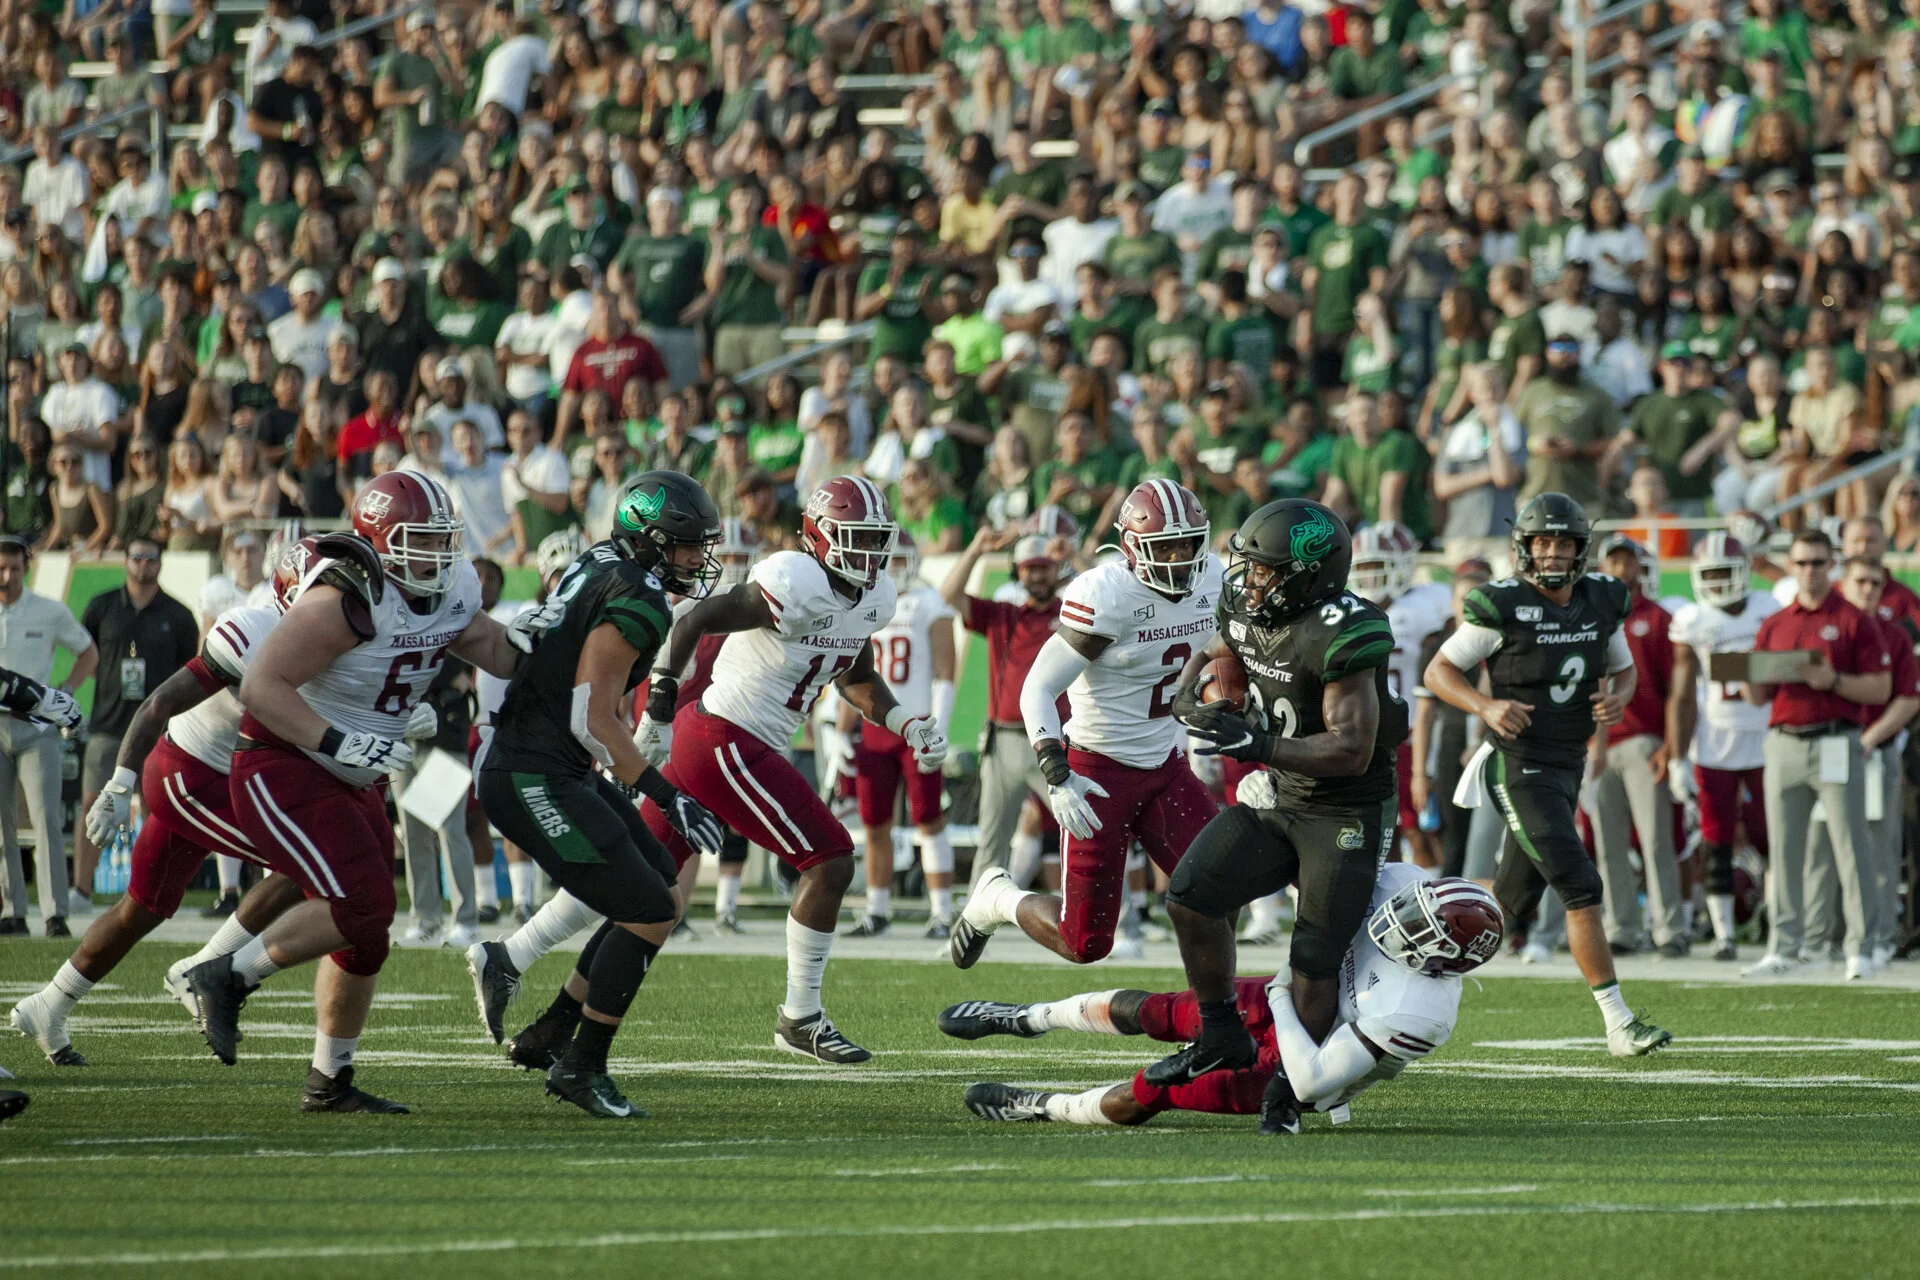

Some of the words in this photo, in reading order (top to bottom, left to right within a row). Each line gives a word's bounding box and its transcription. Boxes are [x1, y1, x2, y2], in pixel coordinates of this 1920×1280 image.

[1320, 596, 1366, 625] 32
[1138, 617, 1214, 643] MASSACHUSETTS
[1536, 631, 1599, 645] CHARLOTTE
[1148, 642, 1192, 720] 2
[1243, 656, 1294, 683] CHARLOTTE
[1550, 656, 1586, 704] 3
[521, 786, 571, 838] MINERS
